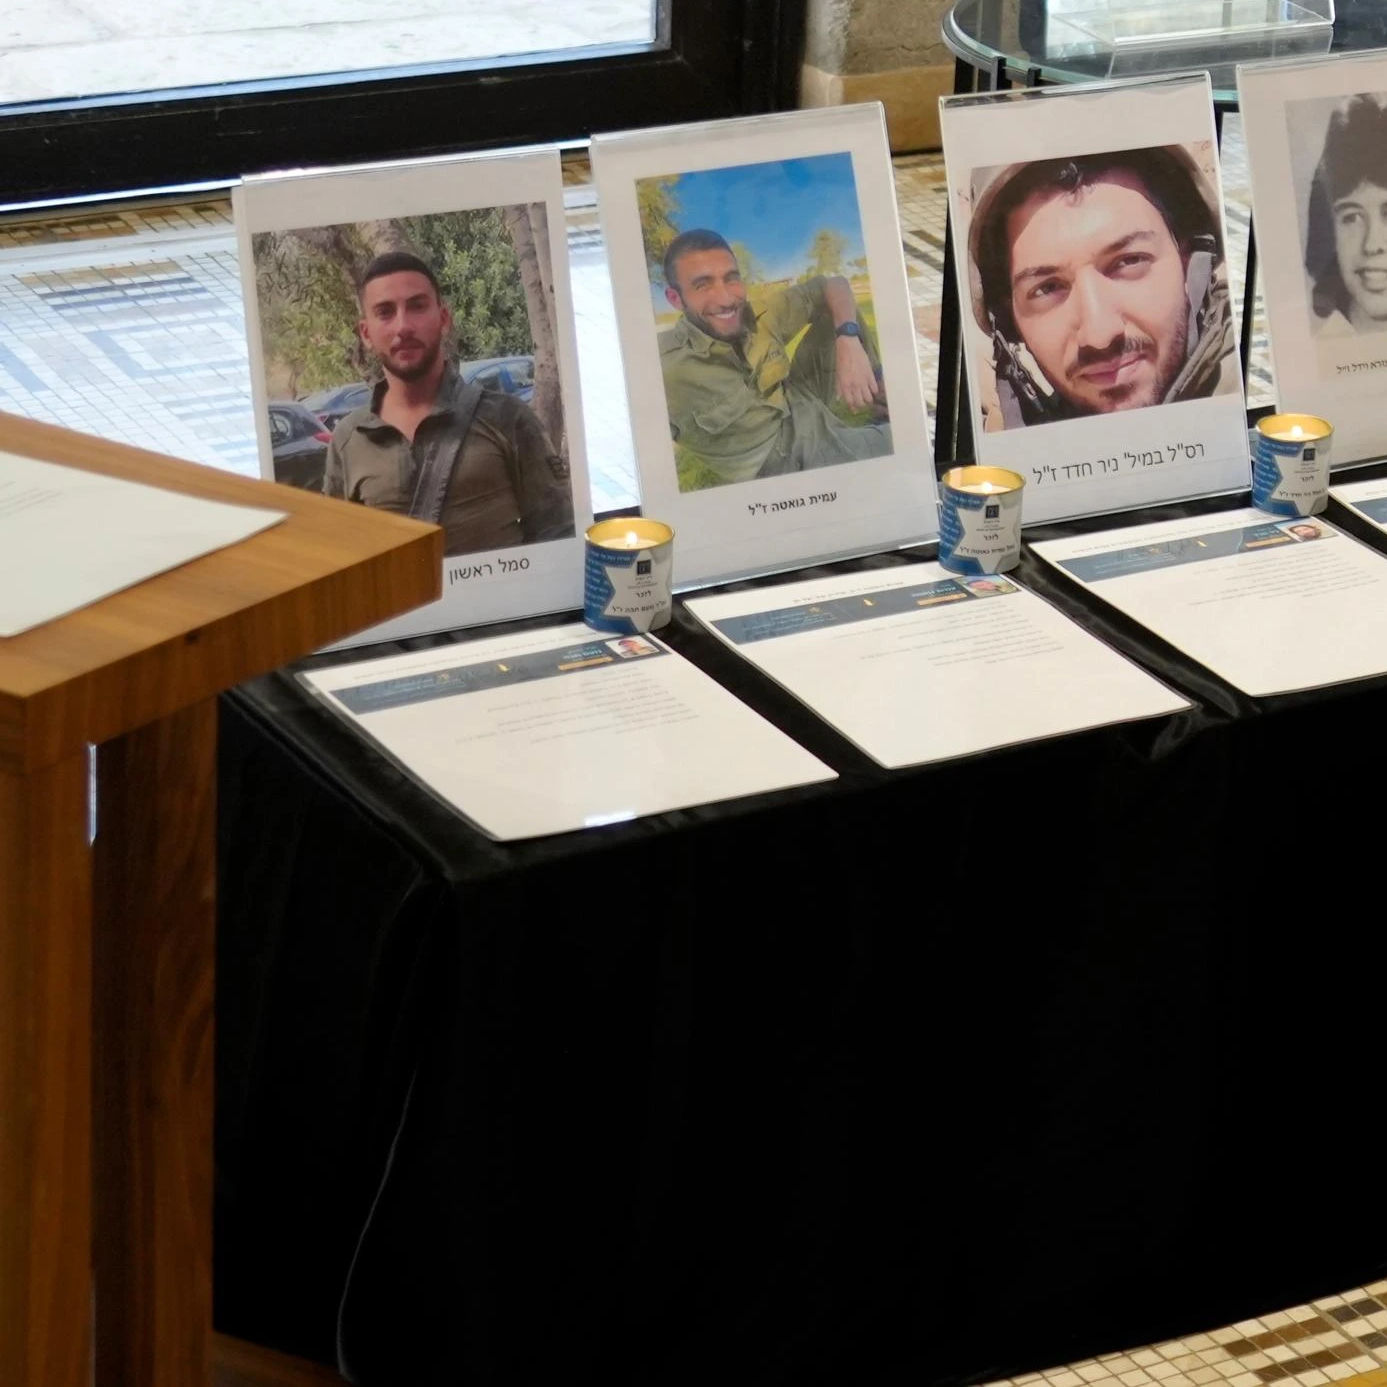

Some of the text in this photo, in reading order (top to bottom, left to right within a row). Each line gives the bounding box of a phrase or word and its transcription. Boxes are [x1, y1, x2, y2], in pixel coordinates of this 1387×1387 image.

[1167, 442, 1205, 462] רס"ל
[1032, 465, 1057, 485] ז"ל
[1061, 462, 1093, 479] חדד
[1097, 457, 1119, 473] ניר
[748, 491, 838, 516] עמית גואטה ז"ל
[449, 558, 530, 586] סמל ראשון
